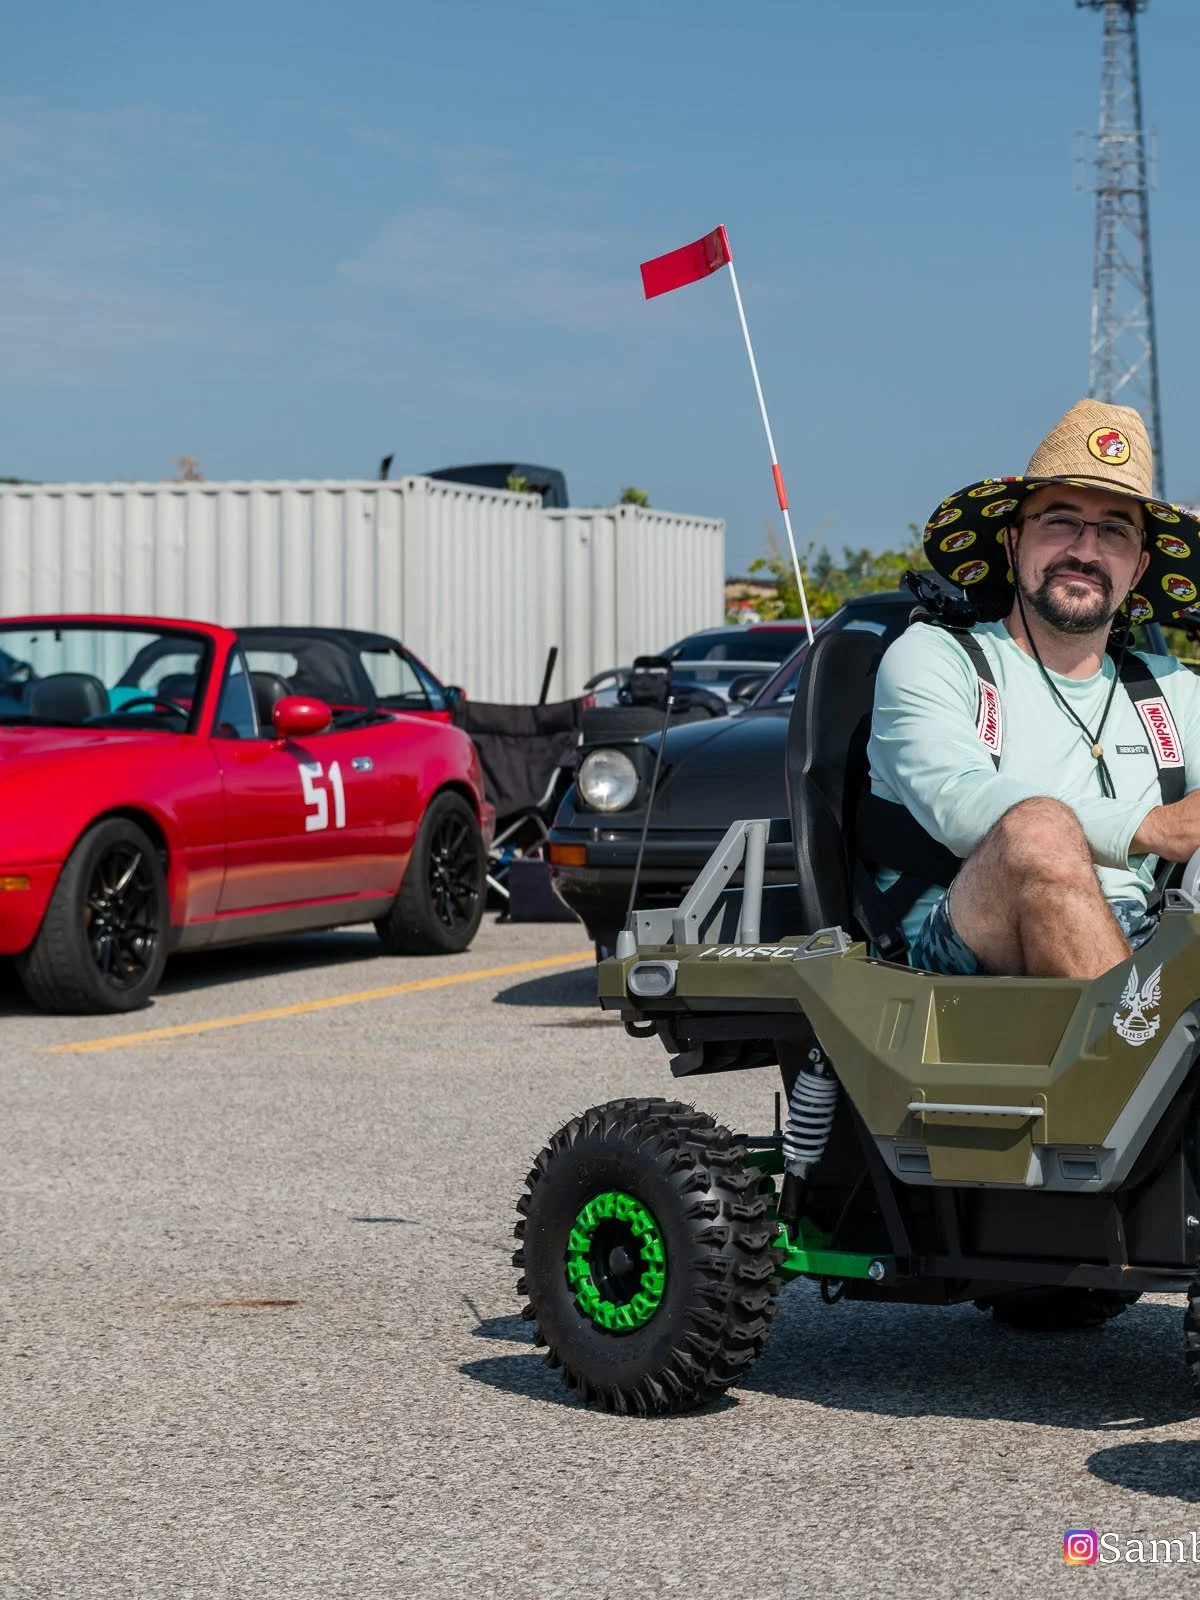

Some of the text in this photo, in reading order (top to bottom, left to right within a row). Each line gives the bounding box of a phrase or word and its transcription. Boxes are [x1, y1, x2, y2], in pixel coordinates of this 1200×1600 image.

[984, 688, 997, 745] SIMPSON
[1147, 707, 1176, 759] SIMPSON
[298, 760, 346, 833] 51
[1121, 1029, 1151, 1039] UNSC
